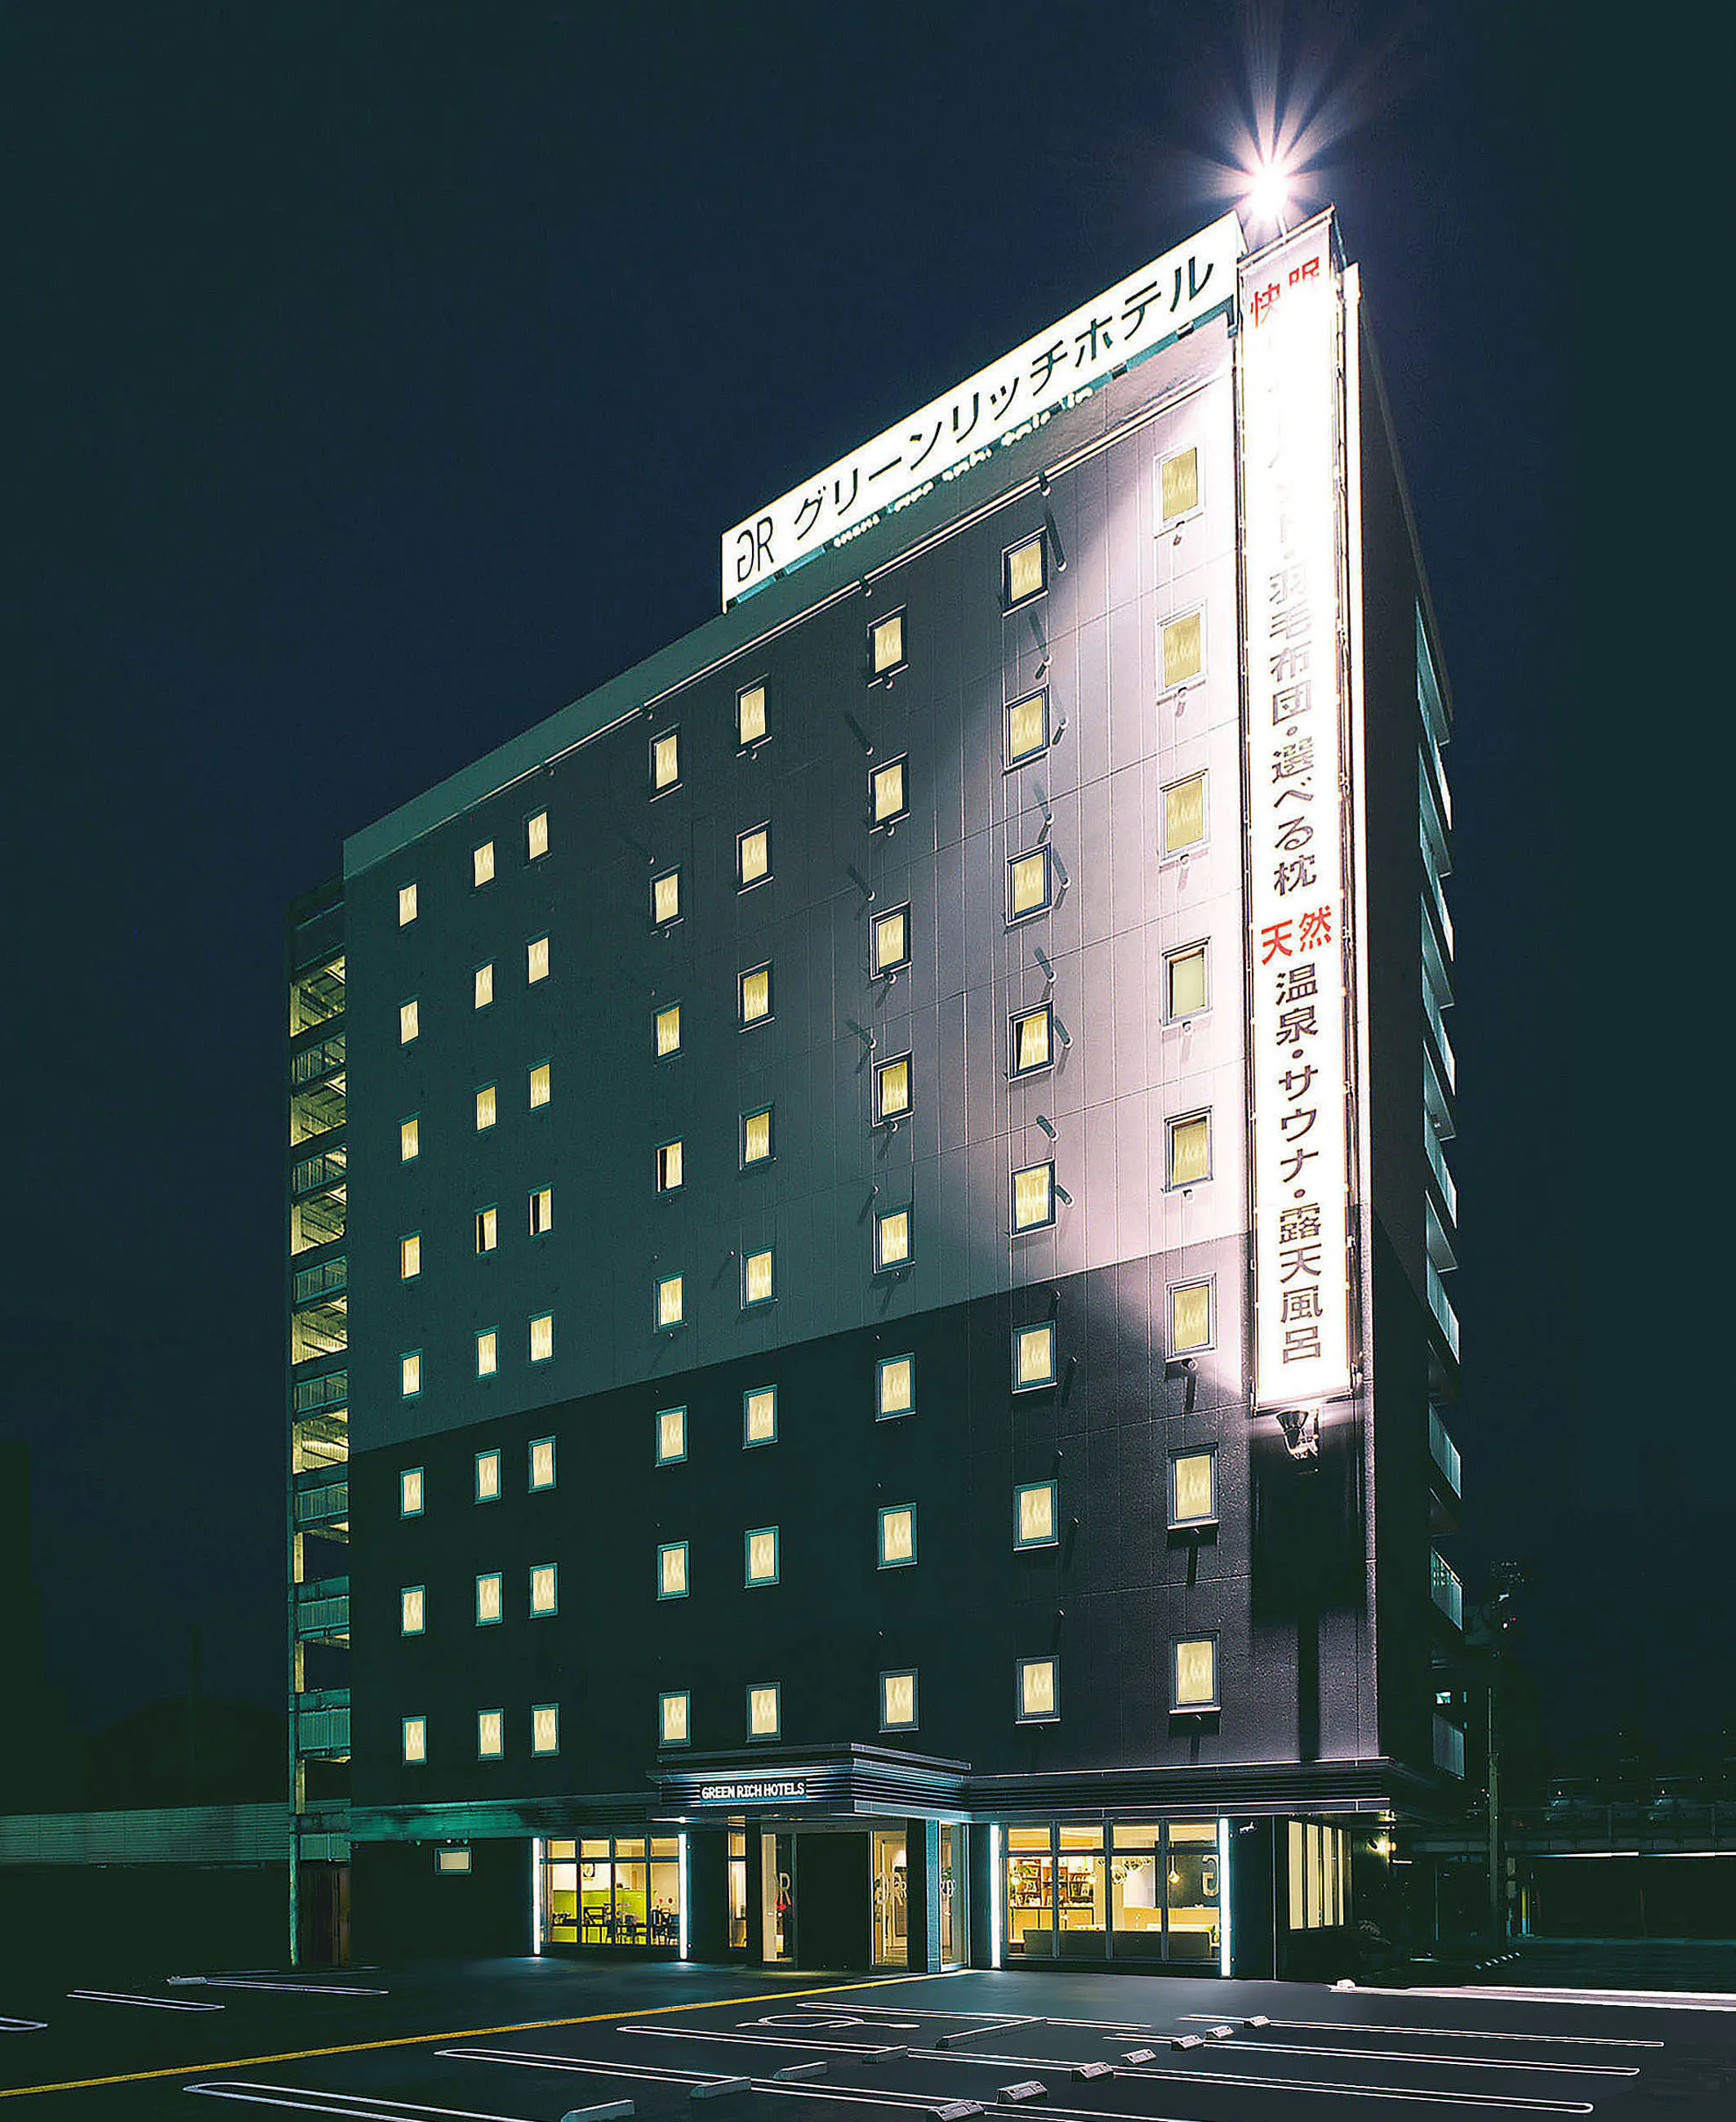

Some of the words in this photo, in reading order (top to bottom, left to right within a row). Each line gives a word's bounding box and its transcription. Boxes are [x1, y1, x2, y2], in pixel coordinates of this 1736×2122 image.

[794, 256, 1214, 541] グリーンリッチホテル
[1262, 905, 1332, 965] 天然
[701, 1785, 735, 1799] GREEN
[737, 1784, 762, 1799] RICH
[763, 1782, 805, 1797] HOTELS
